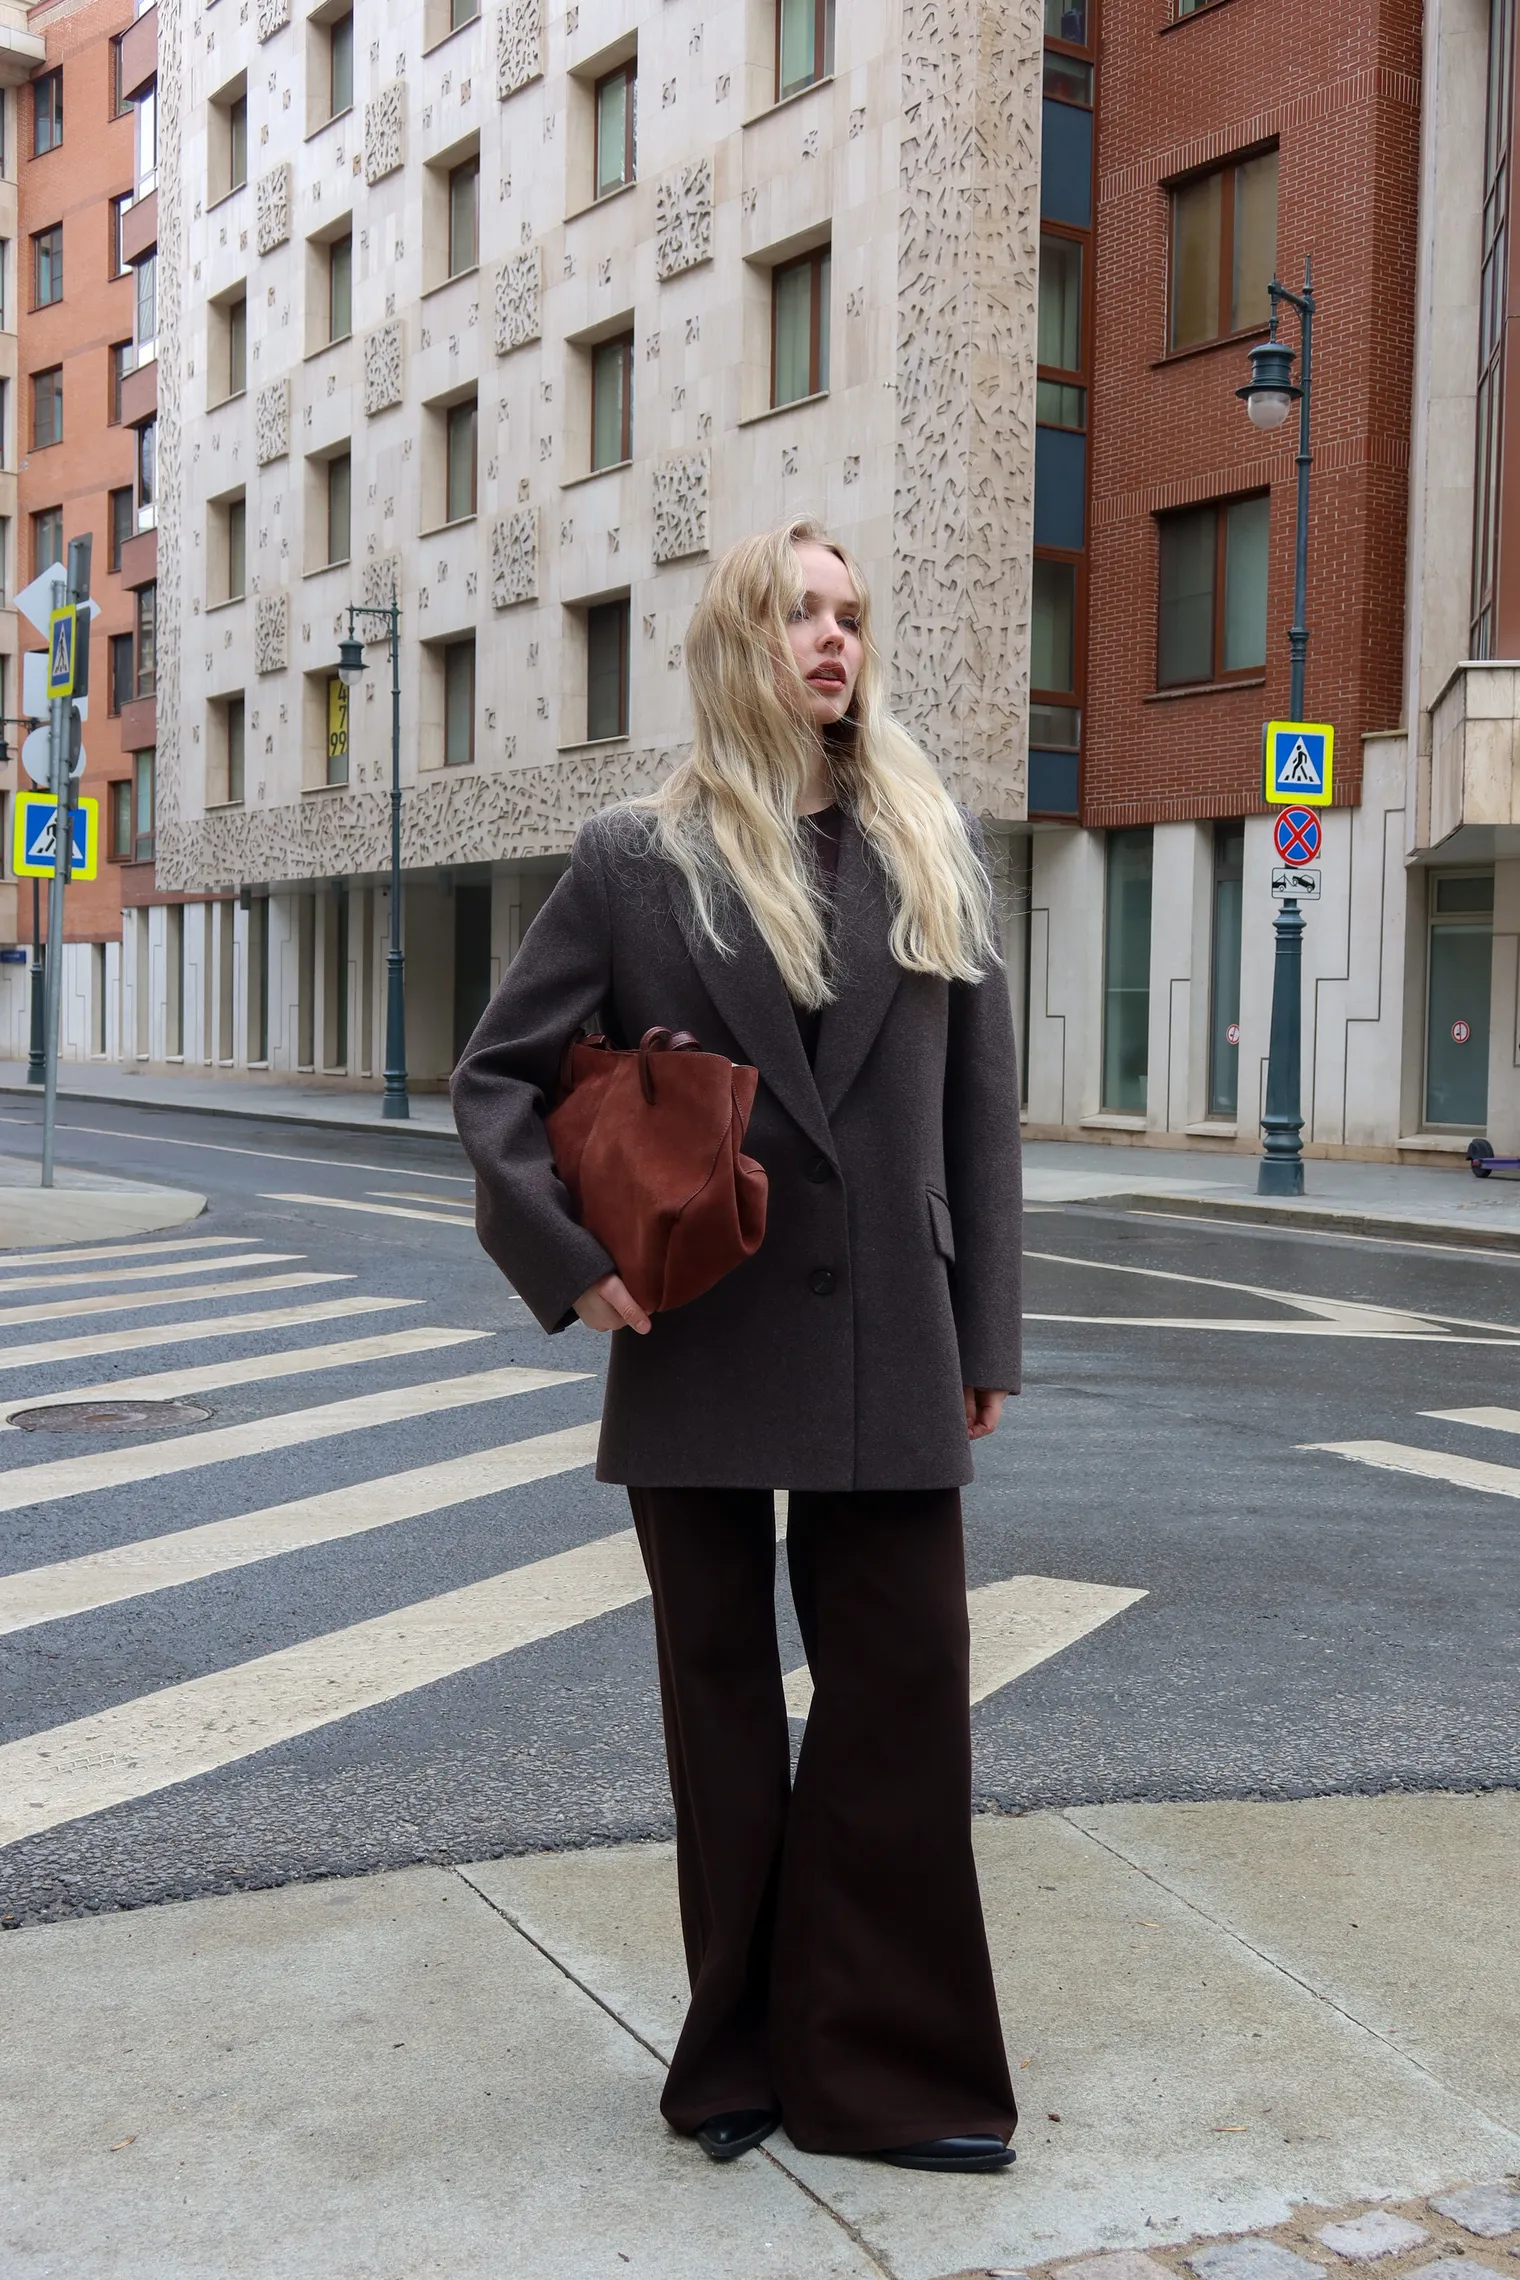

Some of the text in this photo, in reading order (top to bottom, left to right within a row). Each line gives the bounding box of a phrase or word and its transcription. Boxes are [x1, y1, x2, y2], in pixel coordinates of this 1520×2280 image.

[338, 681, 347, 702] 4
[339, 704, 347, 729] 7
[331, 731, 347, 756] 99
